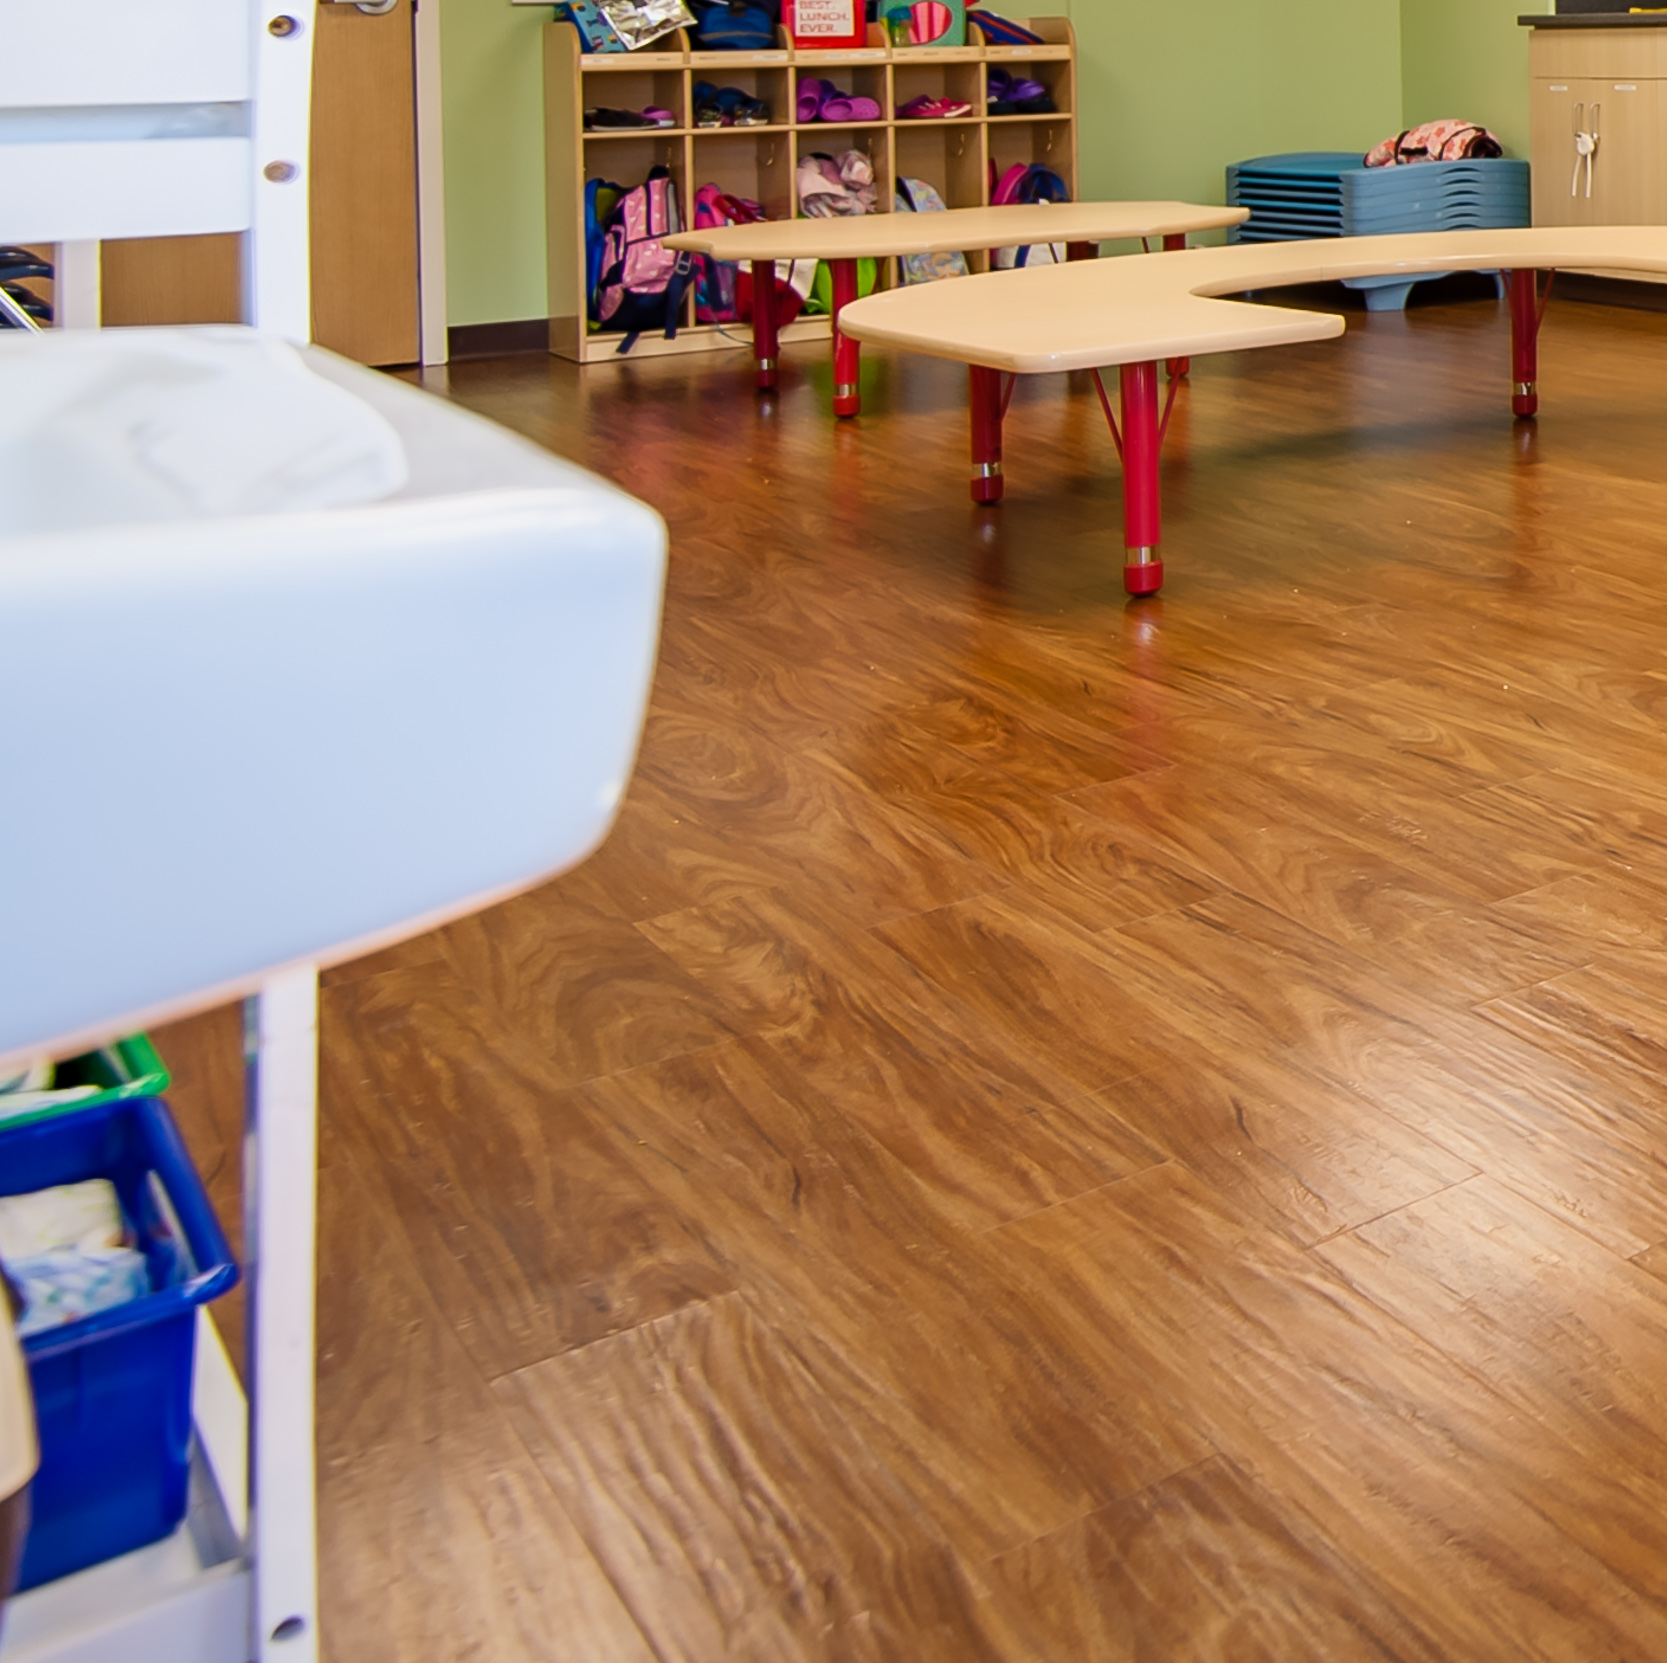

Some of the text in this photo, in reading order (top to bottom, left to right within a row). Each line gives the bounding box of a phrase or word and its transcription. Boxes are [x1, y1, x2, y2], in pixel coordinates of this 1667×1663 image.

[800, 0, 835, 10] BEST.
[800, 12, 849, 22] LUNCH.
[800, 23, 837, 33] EVER.
